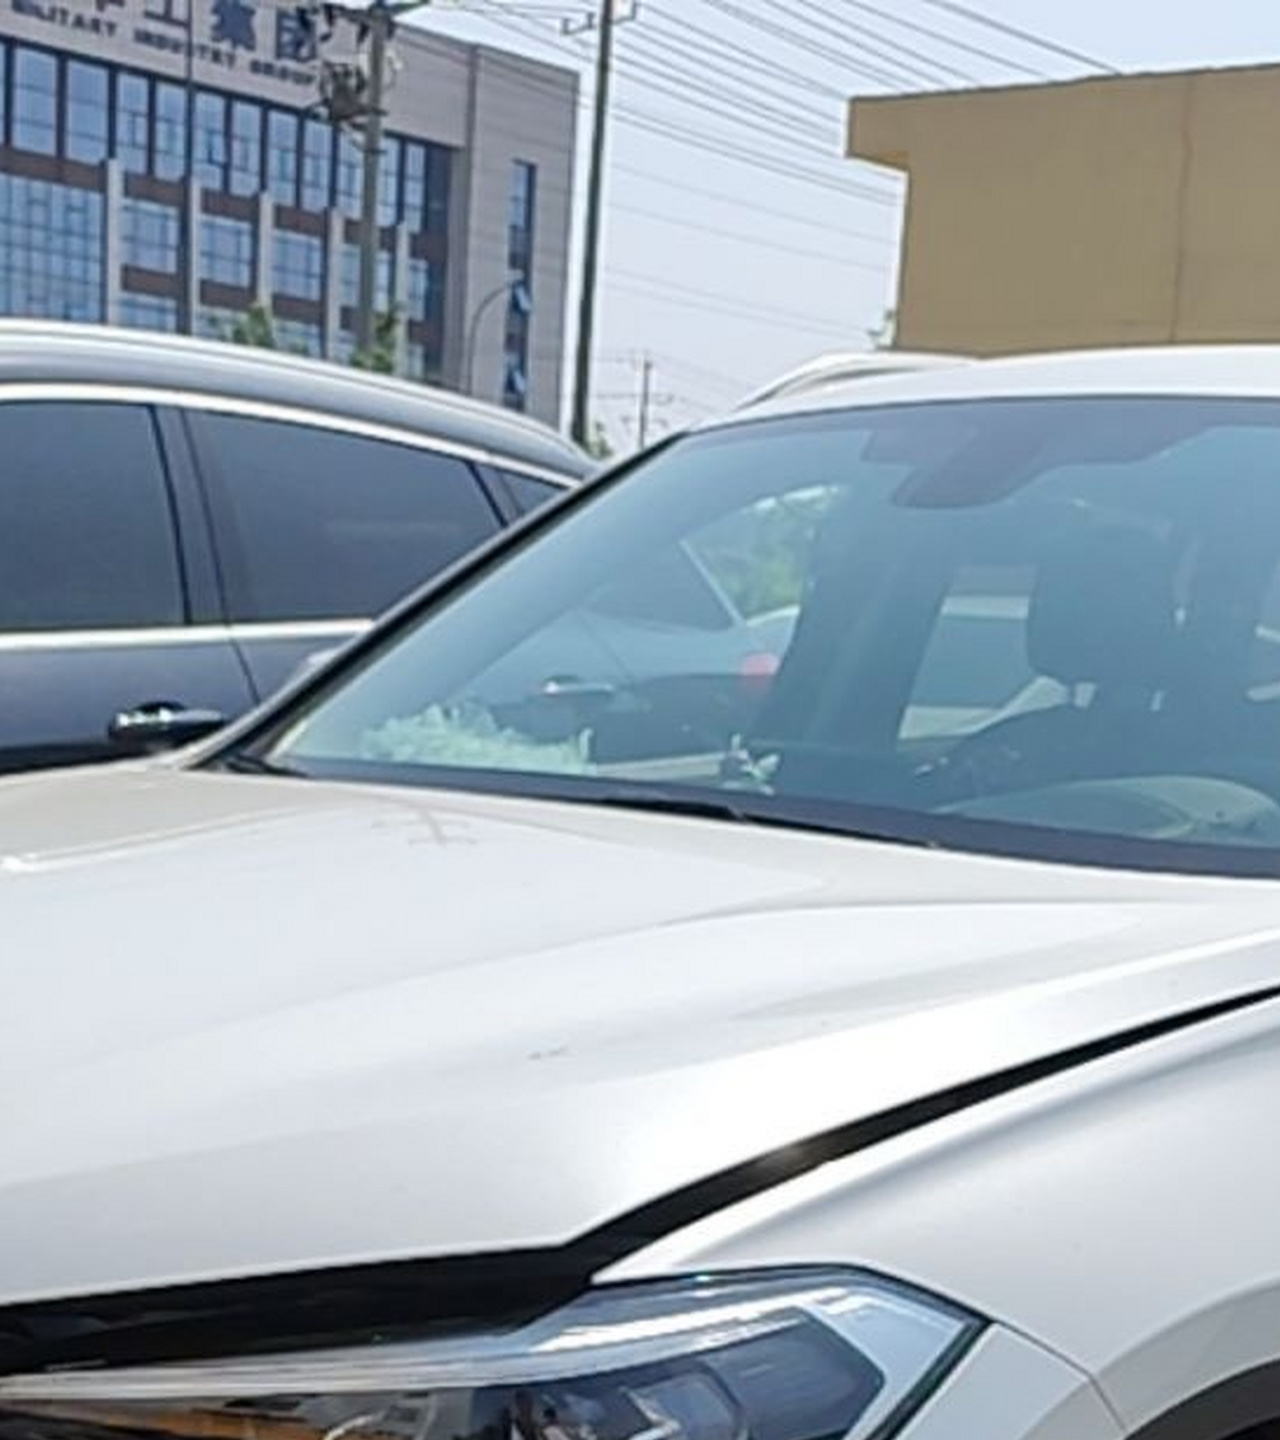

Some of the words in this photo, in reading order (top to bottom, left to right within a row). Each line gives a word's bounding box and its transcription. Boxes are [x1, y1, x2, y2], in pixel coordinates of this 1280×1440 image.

[94, 0, 317, 62] 工集团
[249, 58, 316, 86] GROUP
